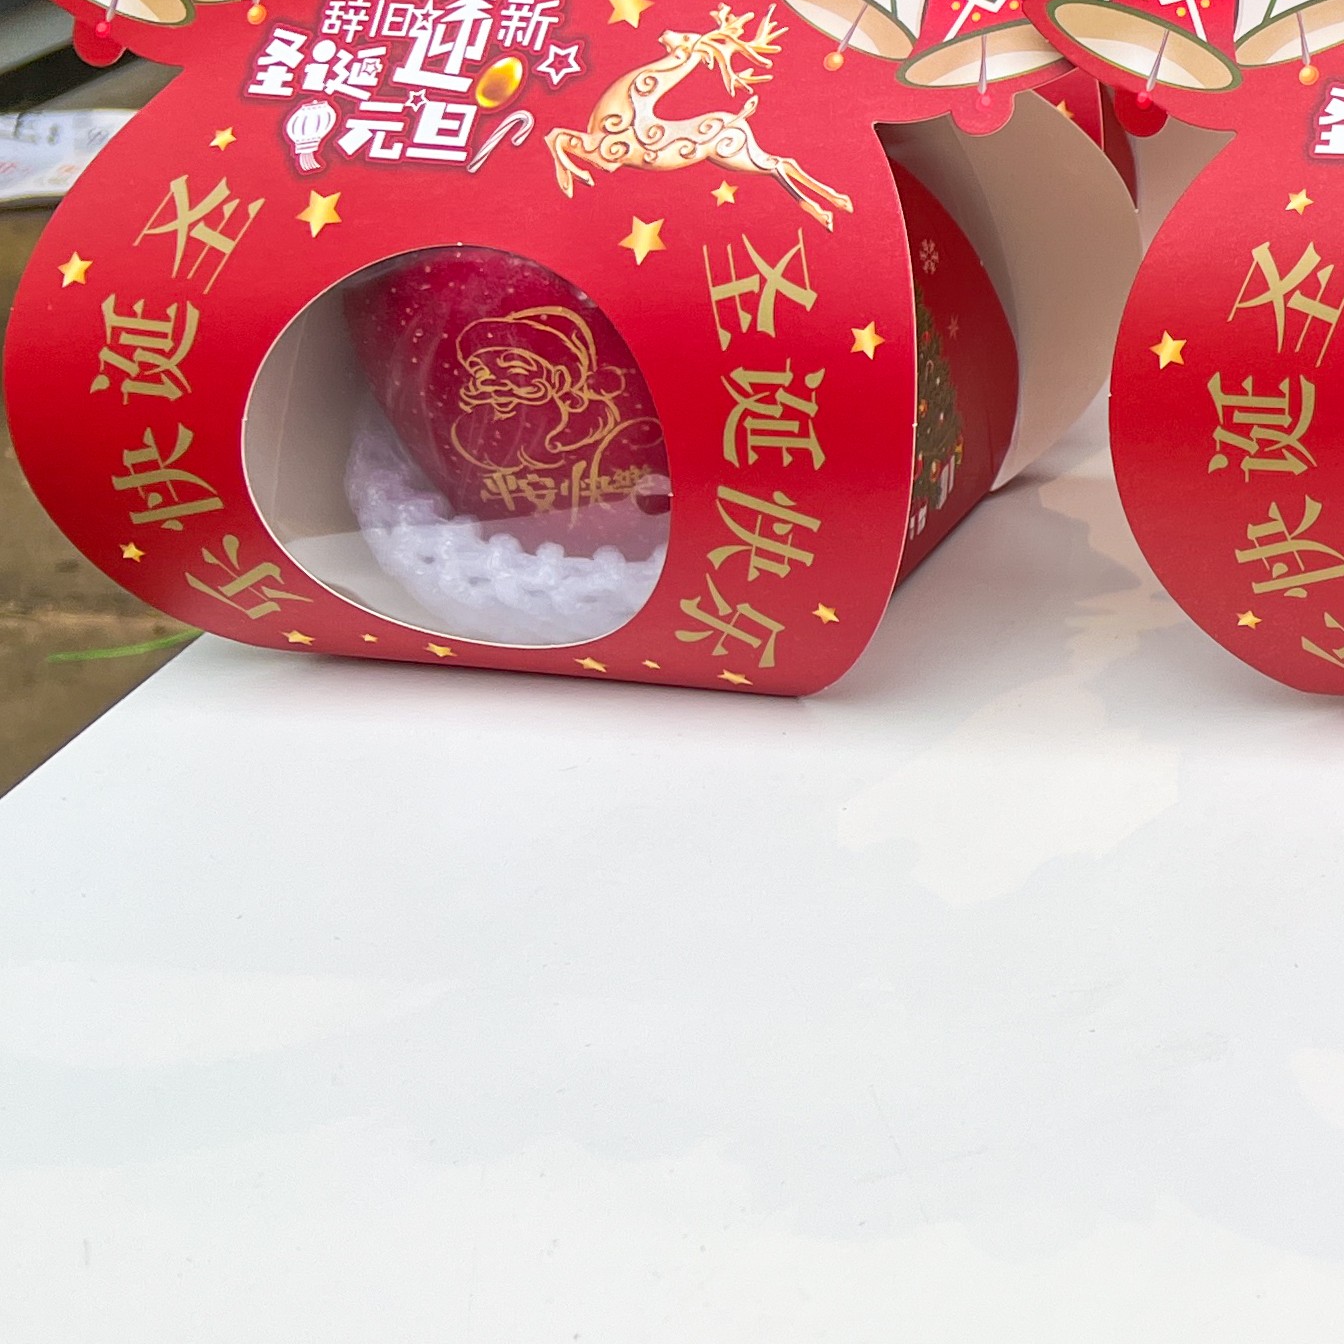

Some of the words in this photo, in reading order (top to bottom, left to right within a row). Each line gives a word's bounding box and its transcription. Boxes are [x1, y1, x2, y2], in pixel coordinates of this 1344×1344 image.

[247, 28, 386, 99] 圣诞
[337, 102, 478, 163] 元旦
[89, 173, 314, 621] 圣诞快乐
[674, 226, 828, 668] 圣诞快乐
